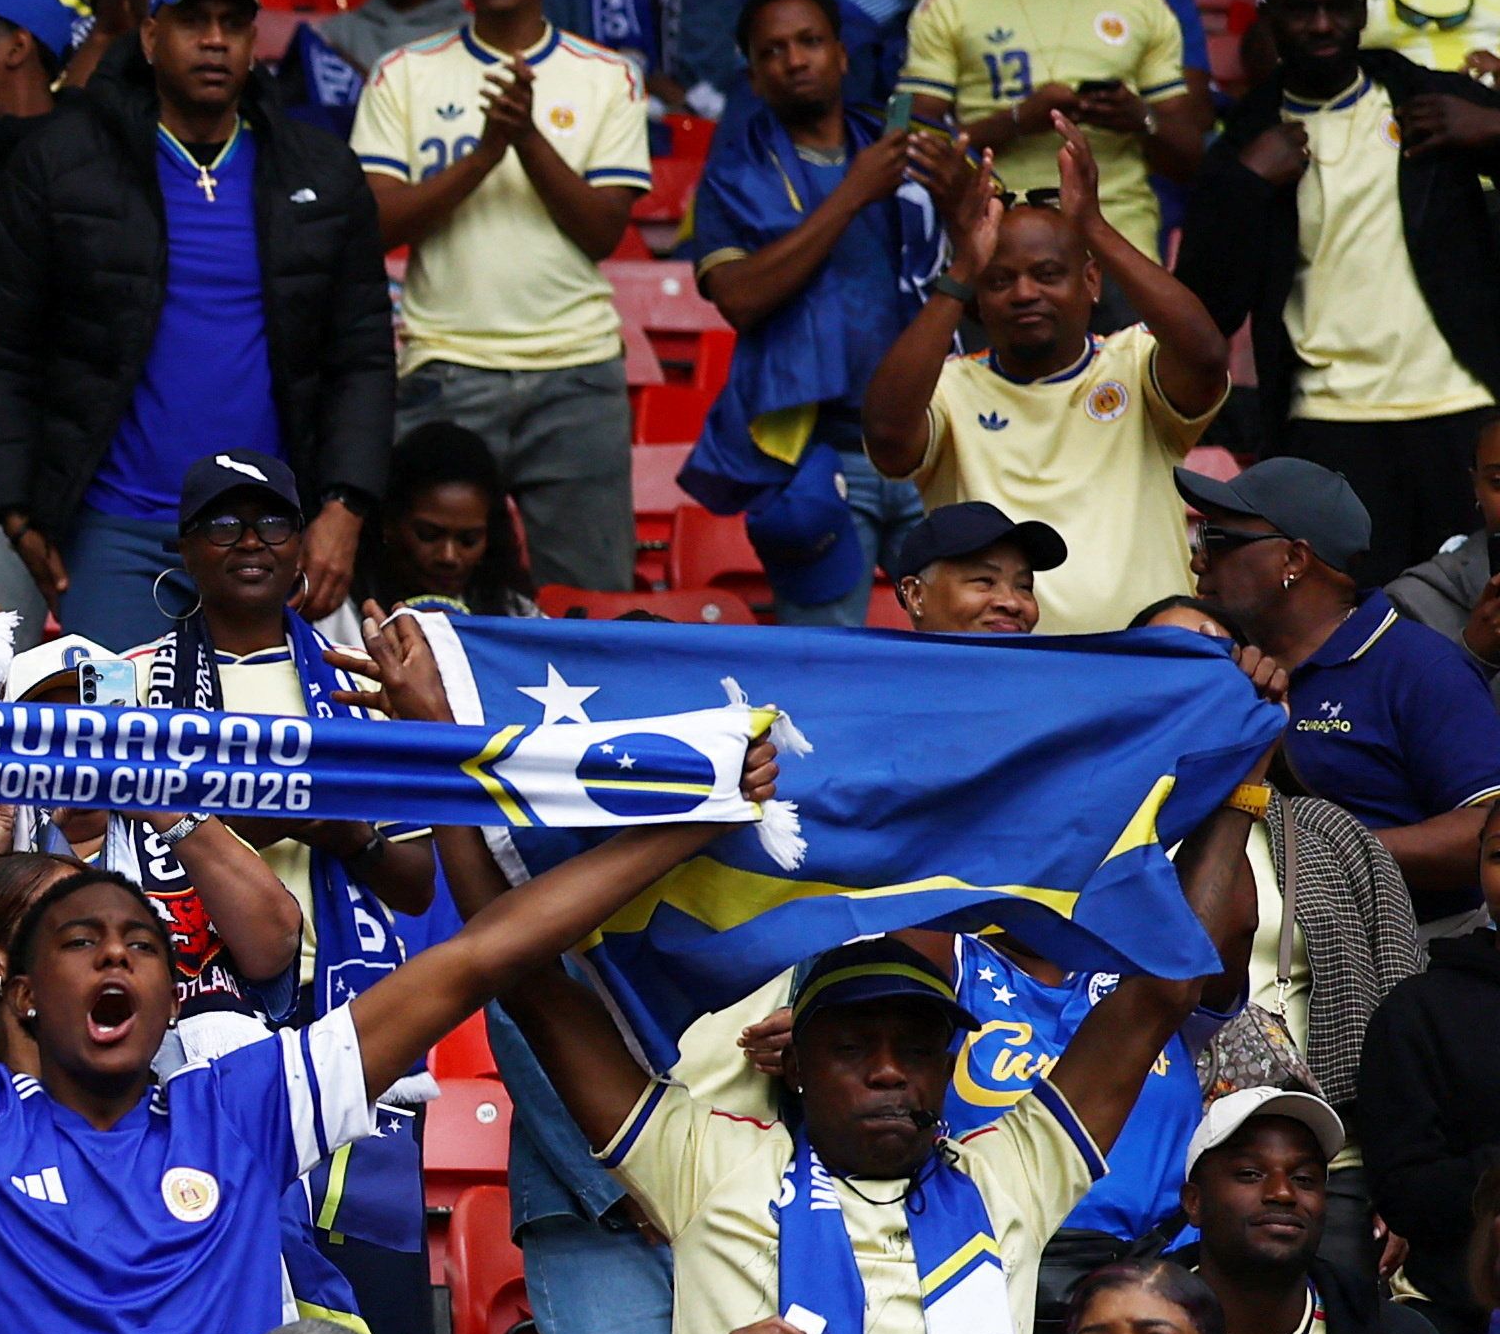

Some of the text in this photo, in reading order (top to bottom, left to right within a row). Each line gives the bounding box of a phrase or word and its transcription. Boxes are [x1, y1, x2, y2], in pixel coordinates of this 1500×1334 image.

[983, 50, 1033, 101] 13
[107, 764, 189, 808] CUP
[202, 769, 314, 814] 2026
